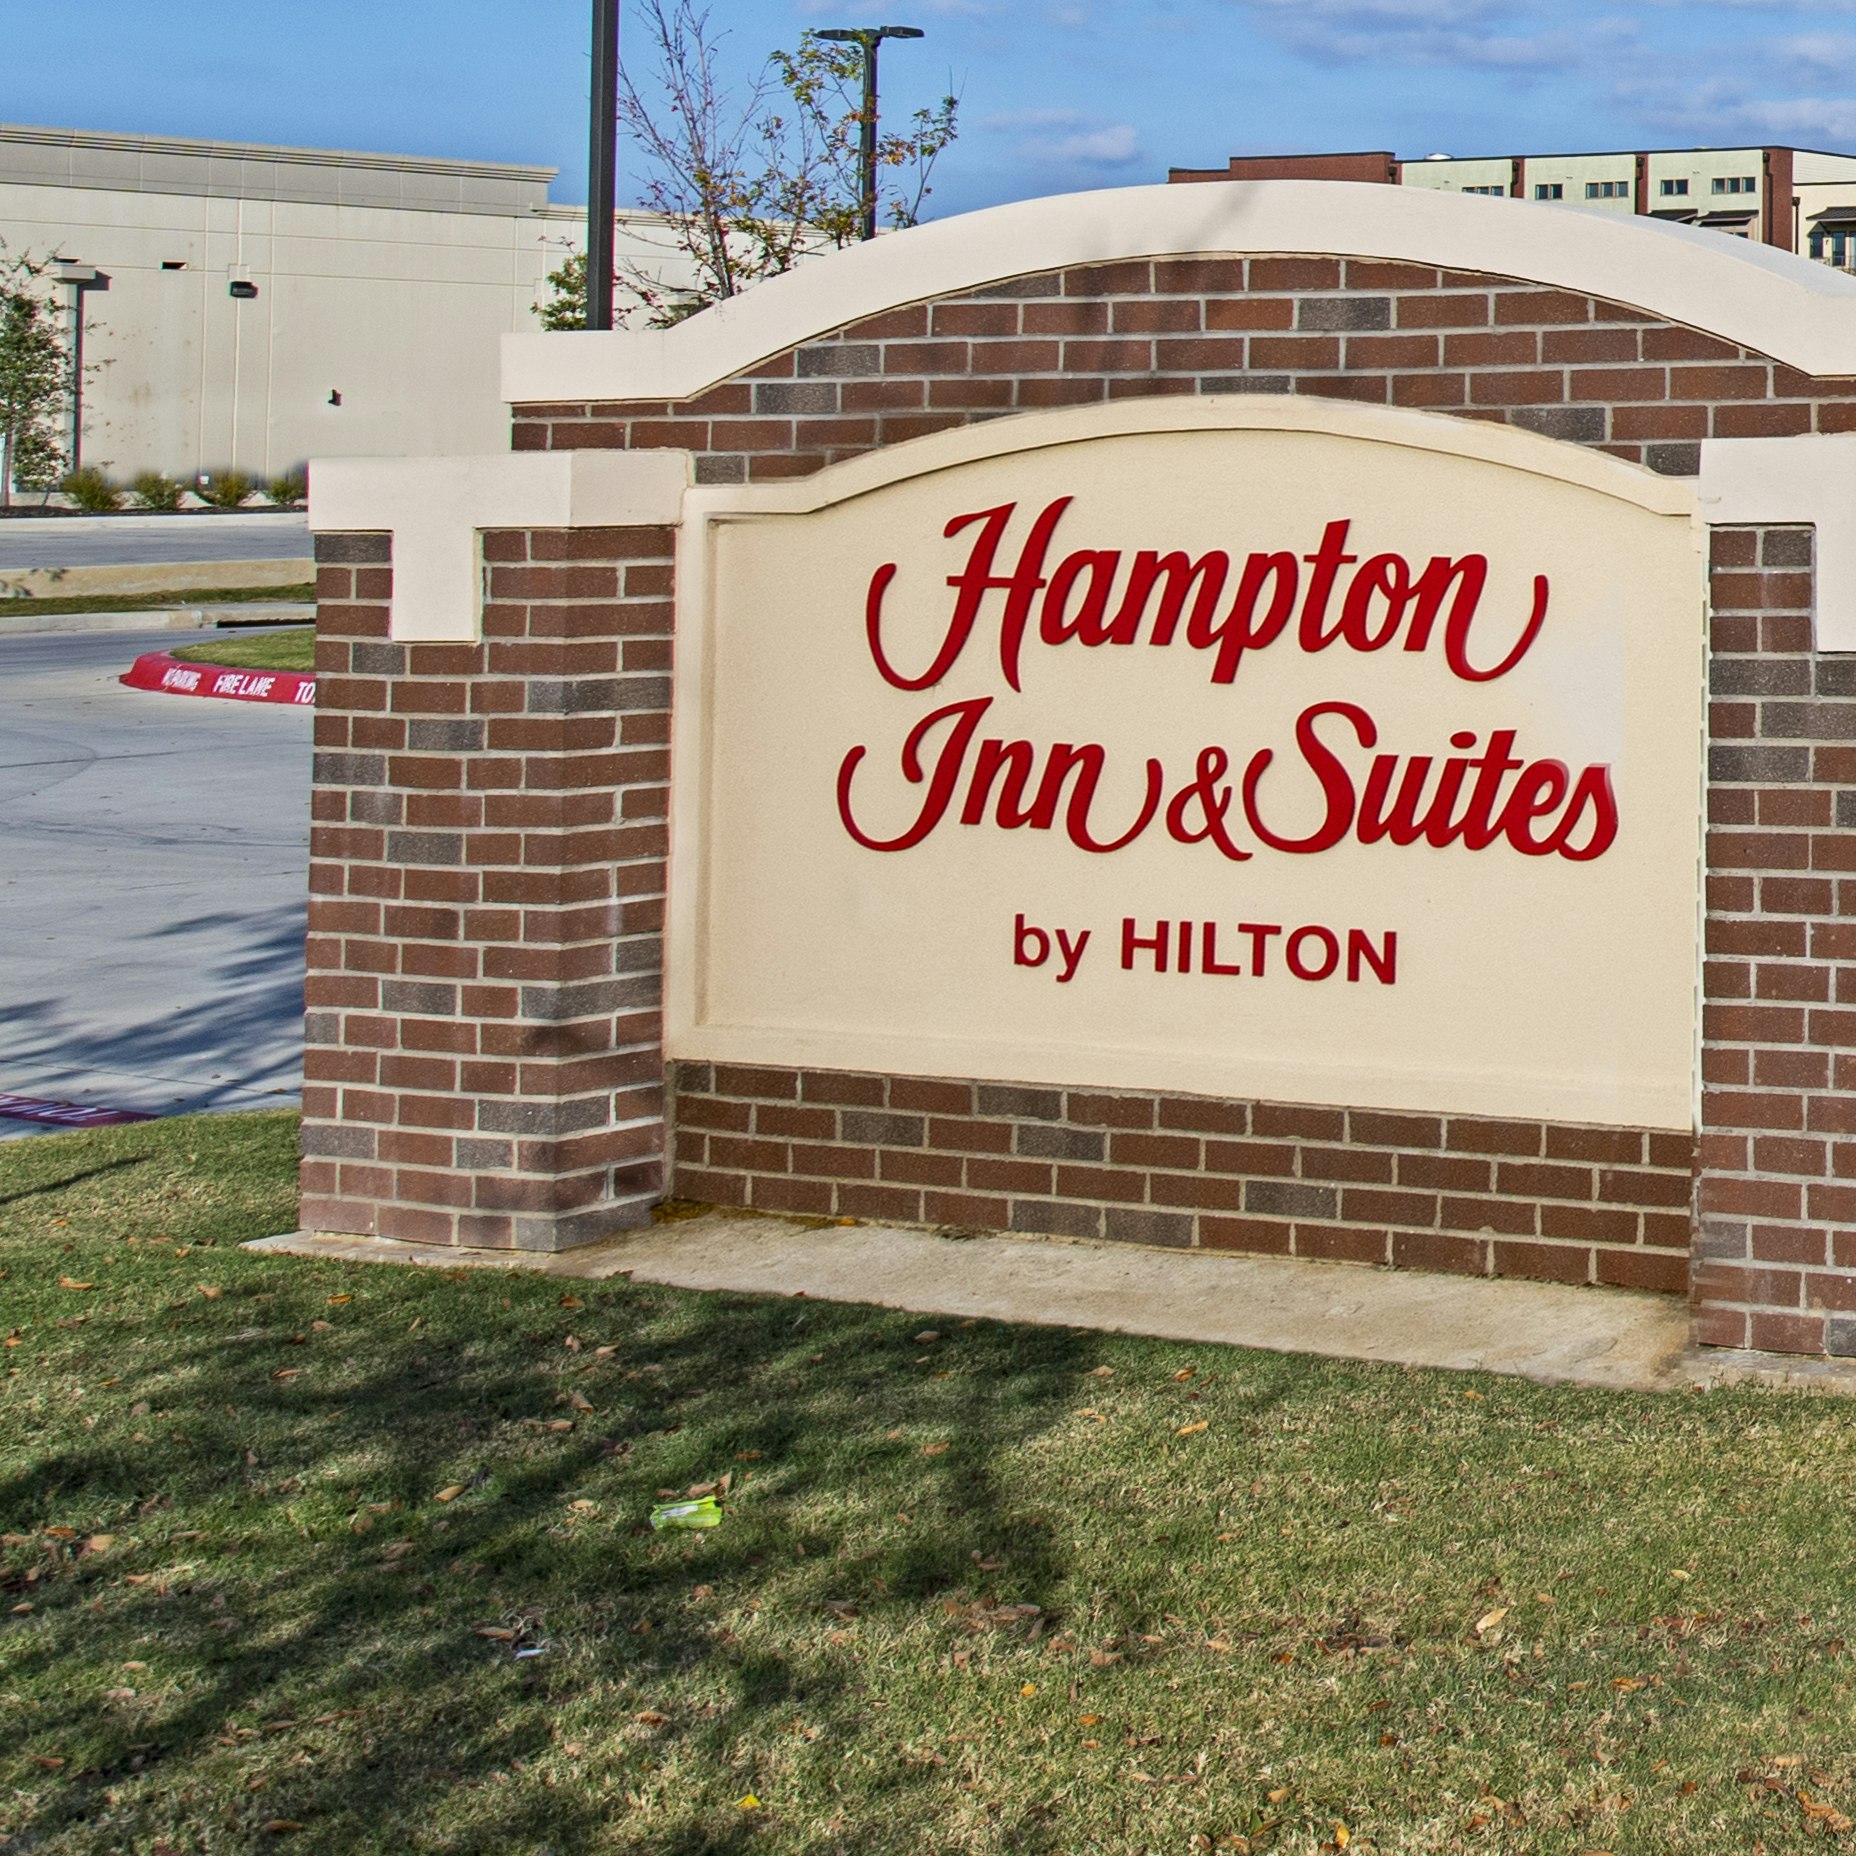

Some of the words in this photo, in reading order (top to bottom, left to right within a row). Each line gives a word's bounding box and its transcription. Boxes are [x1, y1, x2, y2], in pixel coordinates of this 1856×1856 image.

[866, 495, 1549, 691] Hampton
[213, 674, 242, 694] FIRE
[239, 676, 276, 697] LANE
[295, 681, 316, 704] TO
[837, 696, 1163, 853] Inn
[1166, 745, 1253, 861] &
[1243, 700, 1619, 862] Suites
[1014, 913, 1091, 983] by
[1120, 917, 1398, 985] HILTON
